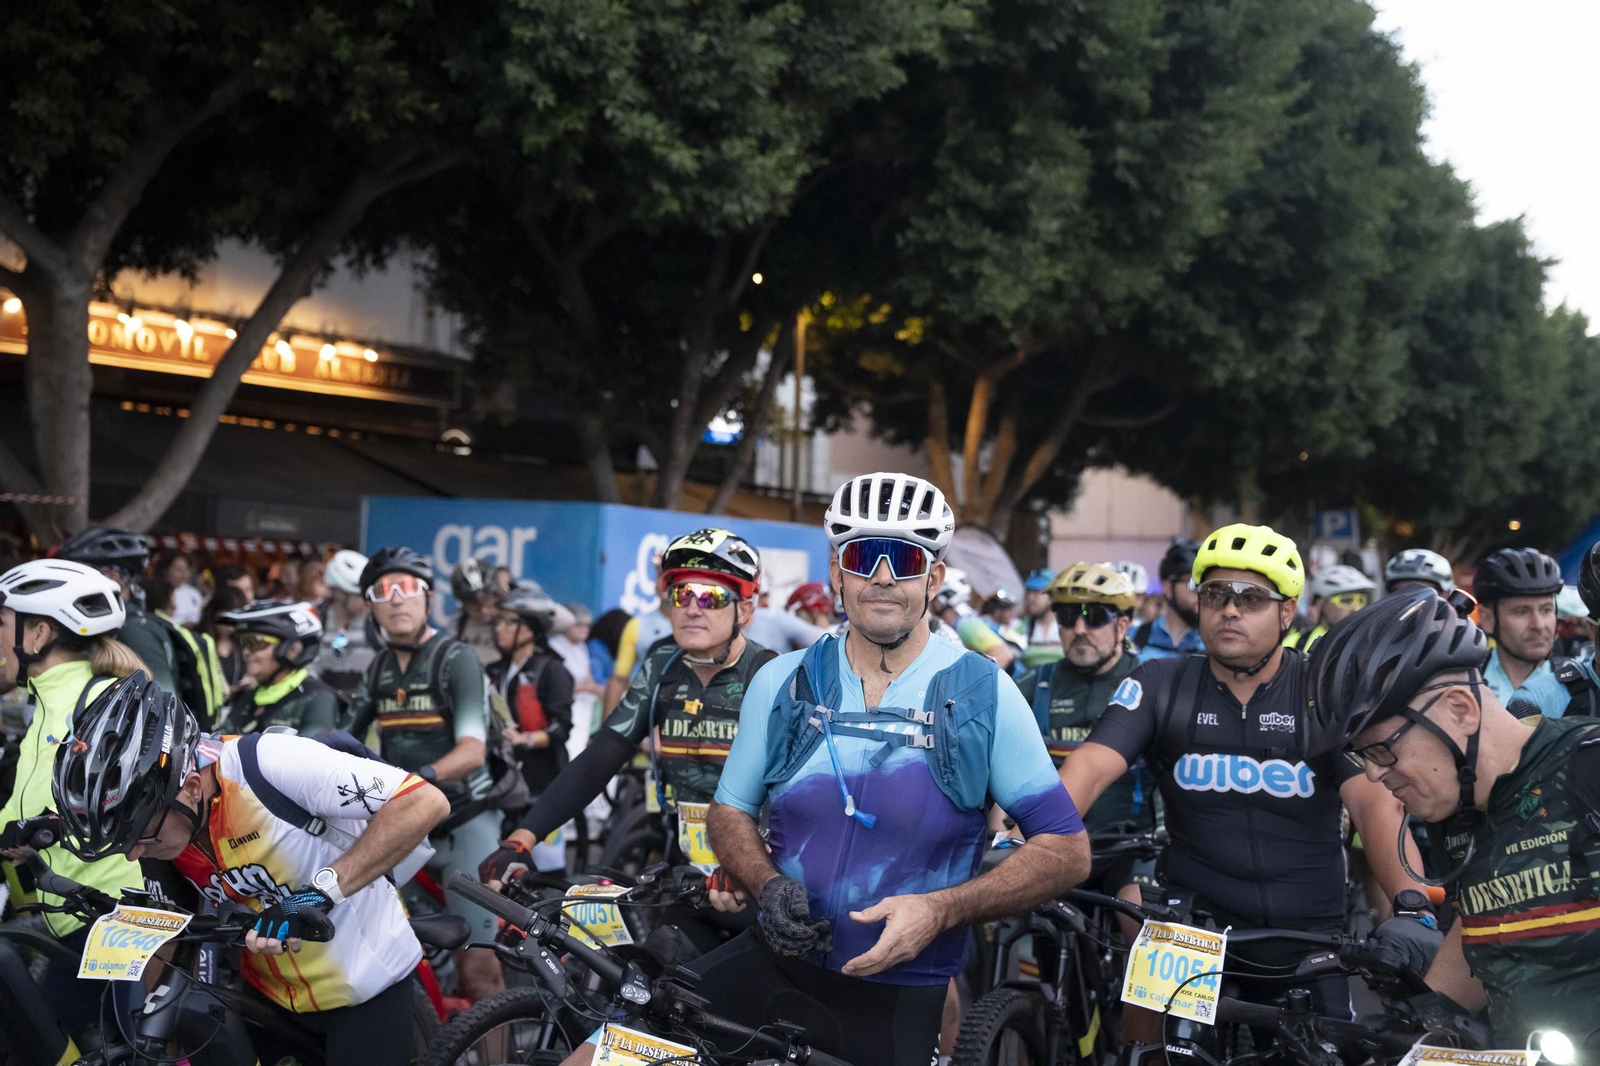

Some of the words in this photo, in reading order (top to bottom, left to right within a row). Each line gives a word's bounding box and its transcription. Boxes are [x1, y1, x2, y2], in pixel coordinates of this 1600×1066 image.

[1321, 510, 1347, 540] P
[1259, 712, 1295, 726] wiber
[161, 725, 173, 754] BADILLO
[1174, 753, 1316, 798] wiber
[1520, 830, 1568, 851] EDICIÓN
[100, 925, 166, 951] 10248
[98, 960, 128, 971] cajamar
[1147, 949, 1218, 992] 10054
[1149, 991, 1193, 1009] cajamar
[1194, 992, 1215, 1002] CARLOS
[620, 1037, 633, 1051] LA
[1165, 1044, 1194, 1057] GALFER
